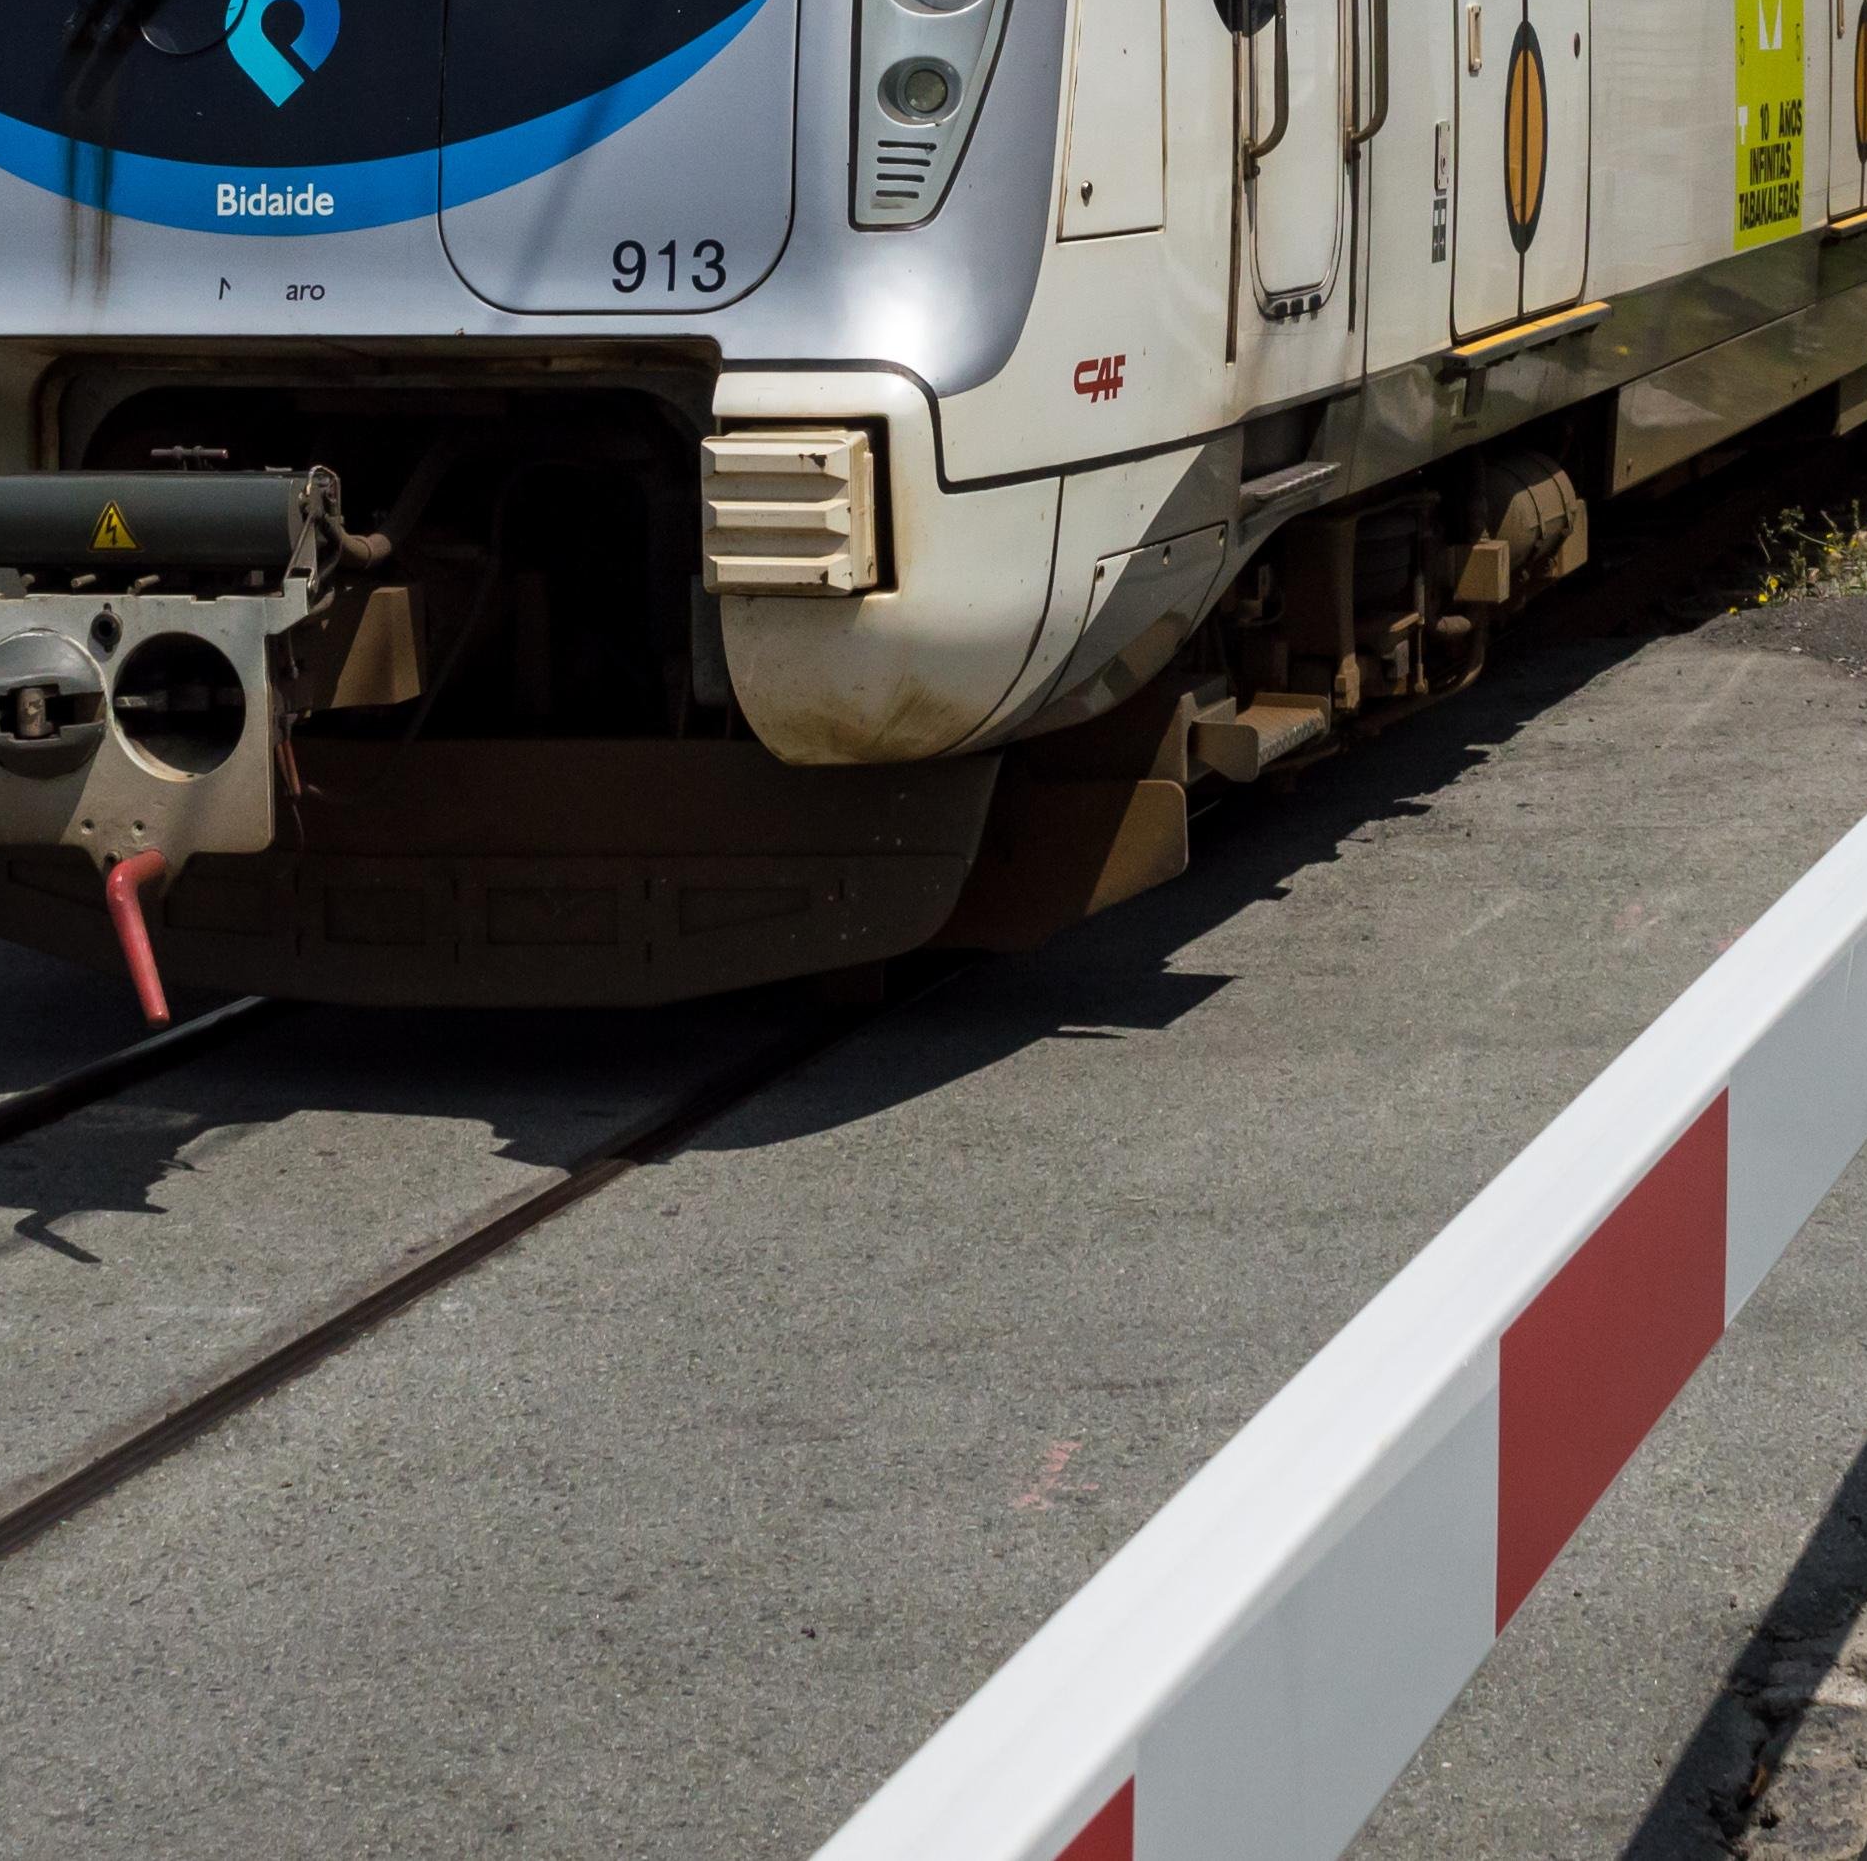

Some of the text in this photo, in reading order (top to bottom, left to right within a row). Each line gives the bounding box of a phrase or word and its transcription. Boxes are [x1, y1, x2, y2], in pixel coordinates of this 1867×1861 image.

[1759, 102, 1770, 141] 10
[1749, 141, 1792, 186] INFINITAS
[216, 182, 335, 217] Bidaide
[1738, 180, 1800, 232] TABAKALERAS
[611, 239, 727, 294] 913
[1073, 353, 1127, 404] CAF
